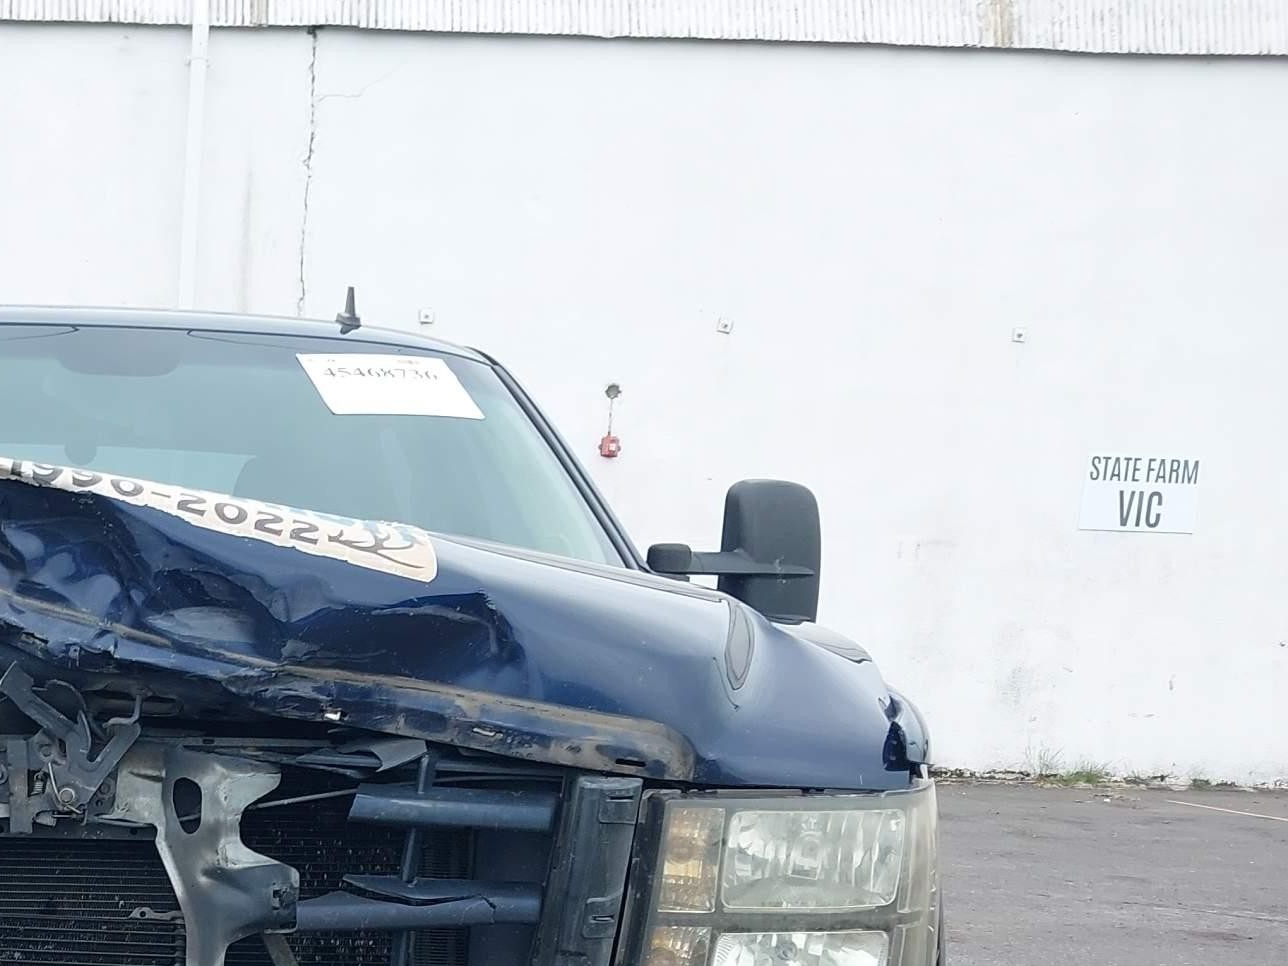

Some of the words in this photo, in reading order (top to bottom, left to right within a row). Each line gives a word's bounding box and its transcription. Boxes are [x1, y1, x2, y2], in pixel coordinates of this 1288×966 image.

[322, 367, 439, 382] 45468736
[1089, 455, 1143, 483] STATE
[1145, 457, 1200, 485] FARM
[1119, 489, 1164, 529] VIC
